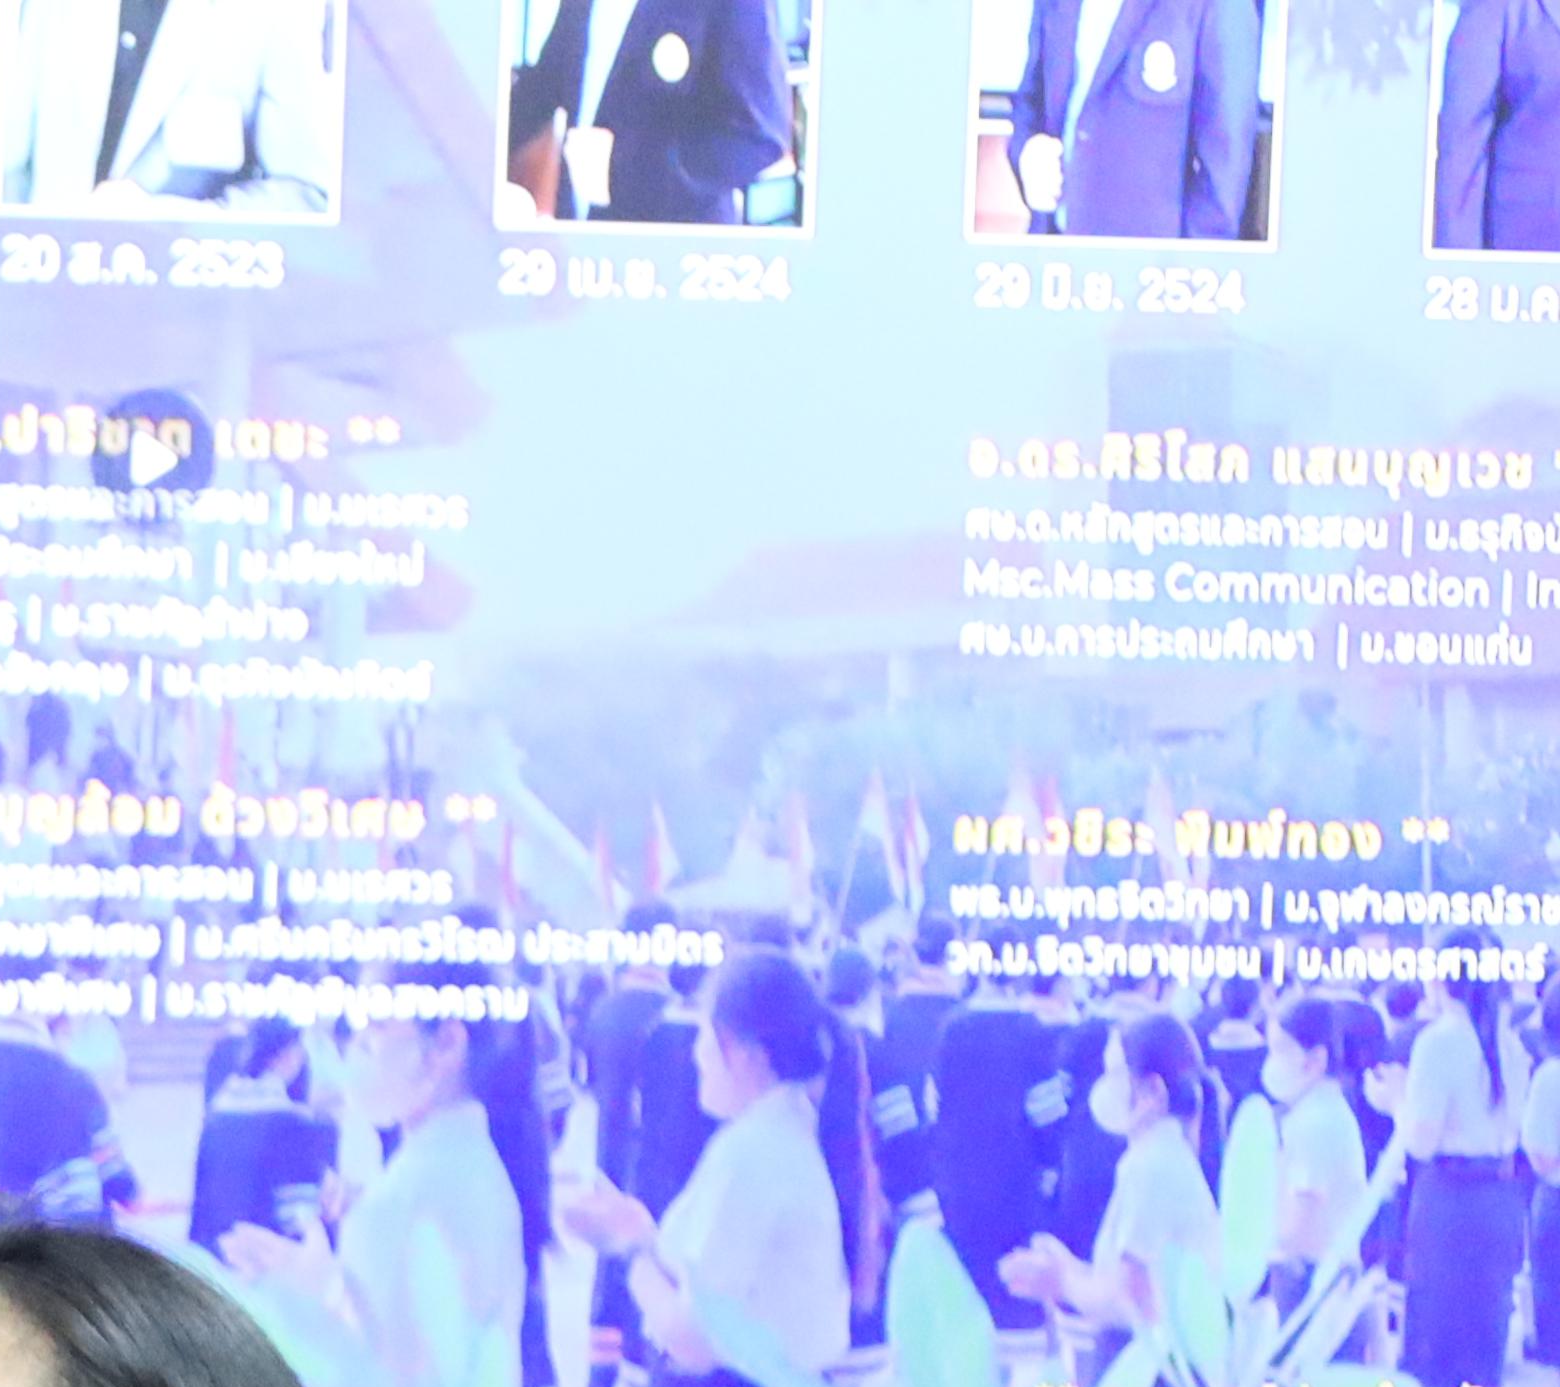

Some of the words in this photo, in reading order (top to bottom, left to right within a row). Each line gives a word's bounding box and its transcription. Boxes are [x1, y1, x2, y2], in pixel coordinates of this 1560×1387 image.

[1, 234, 60, 280] 20
[171, 239, 284, 287] 2523
[680, 254, 791, 301] 2524
[1139, 267, 1245, 313] 2524
[1425, 276, 1478, 320] 28
[1166, 563, 1489, 606] Communication
